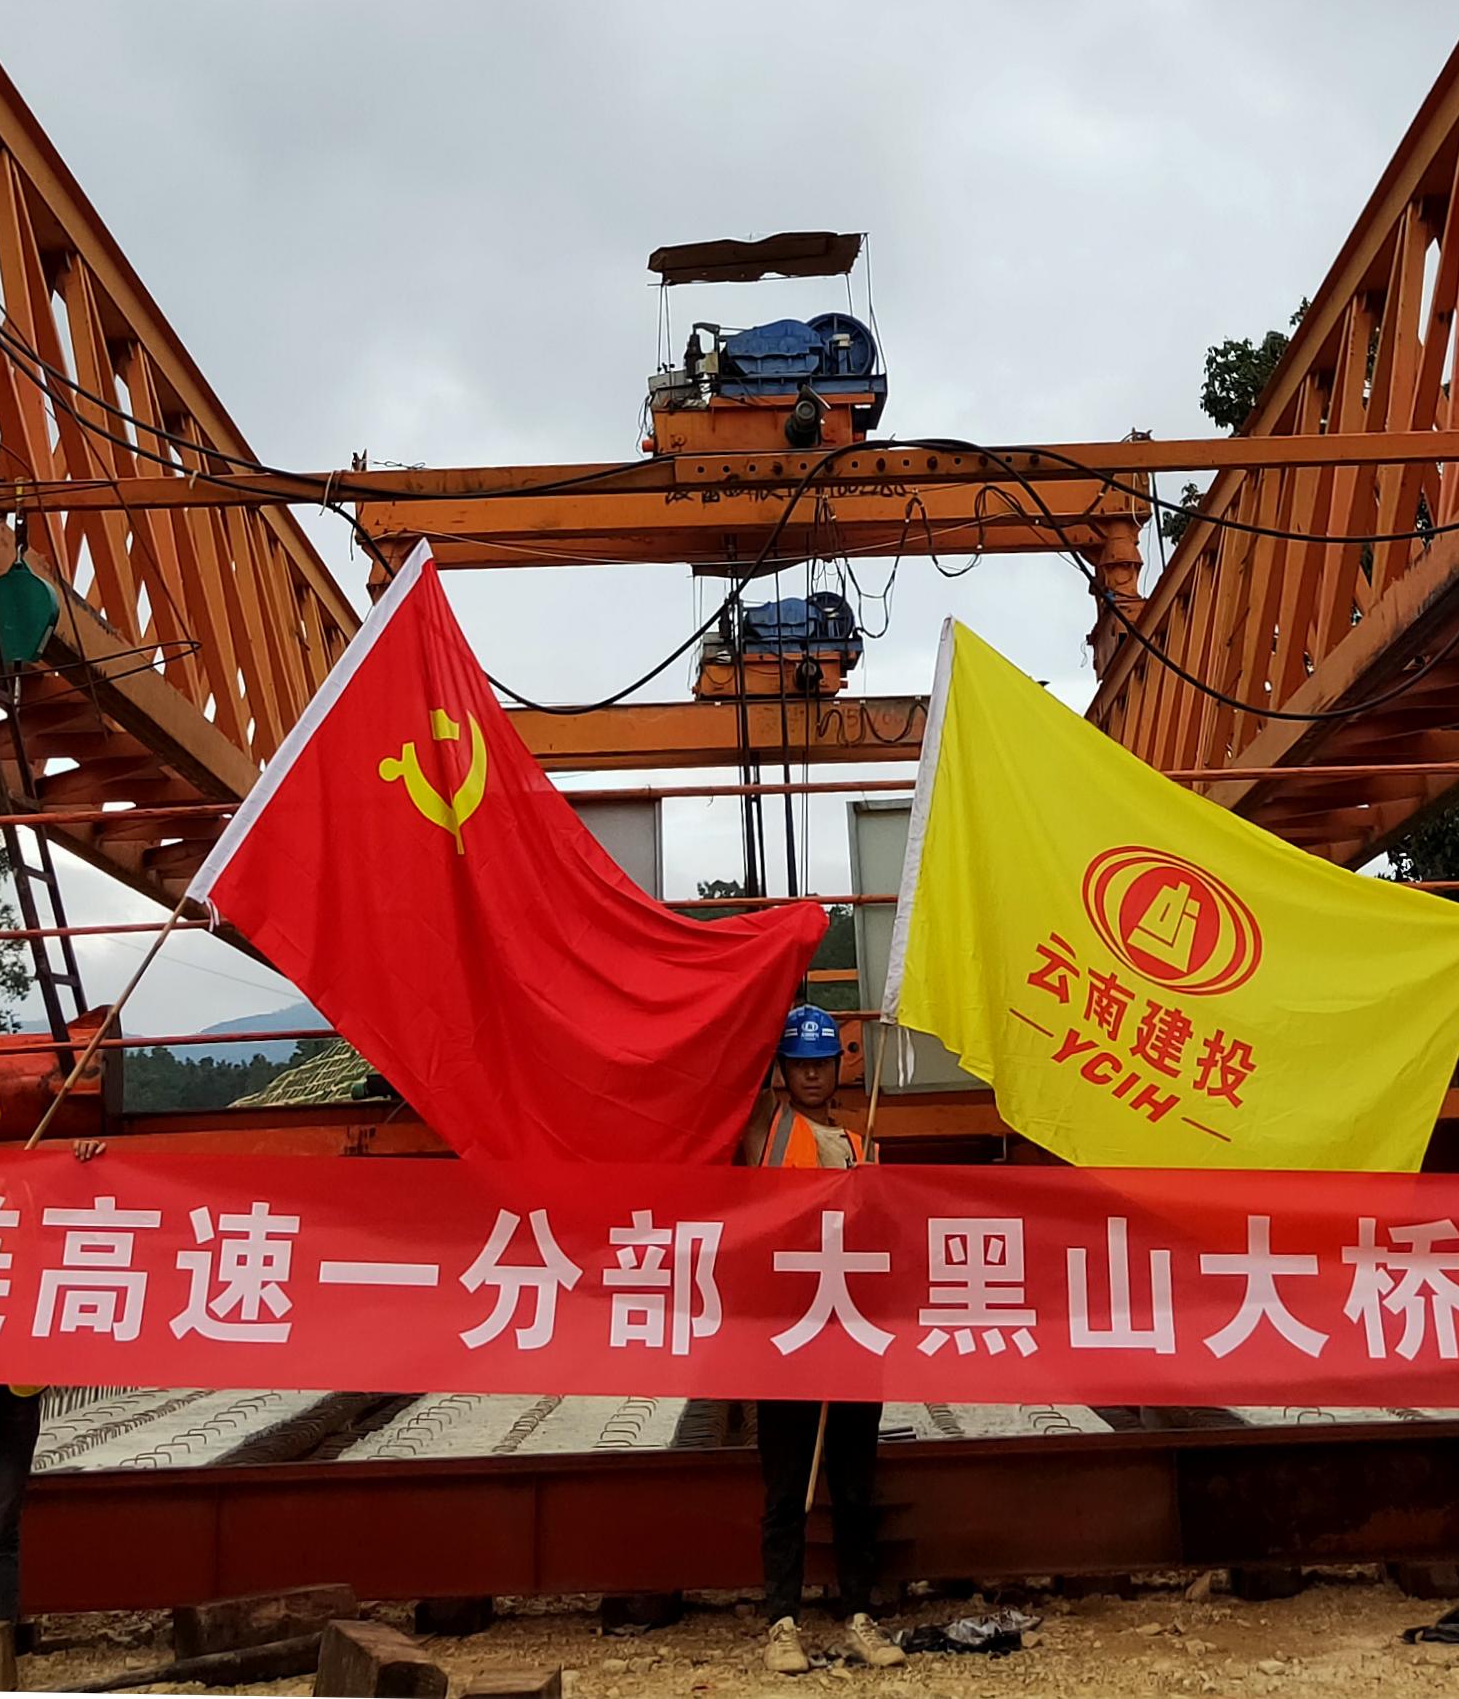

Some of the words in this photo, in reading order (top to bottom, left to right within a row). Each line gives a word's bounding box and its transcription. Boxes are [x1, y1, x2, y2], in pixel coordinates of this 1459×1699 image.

[1025, 932, 1258, 1110] 云南建投
[1051, 1029, 1181, 1124] YCIH
